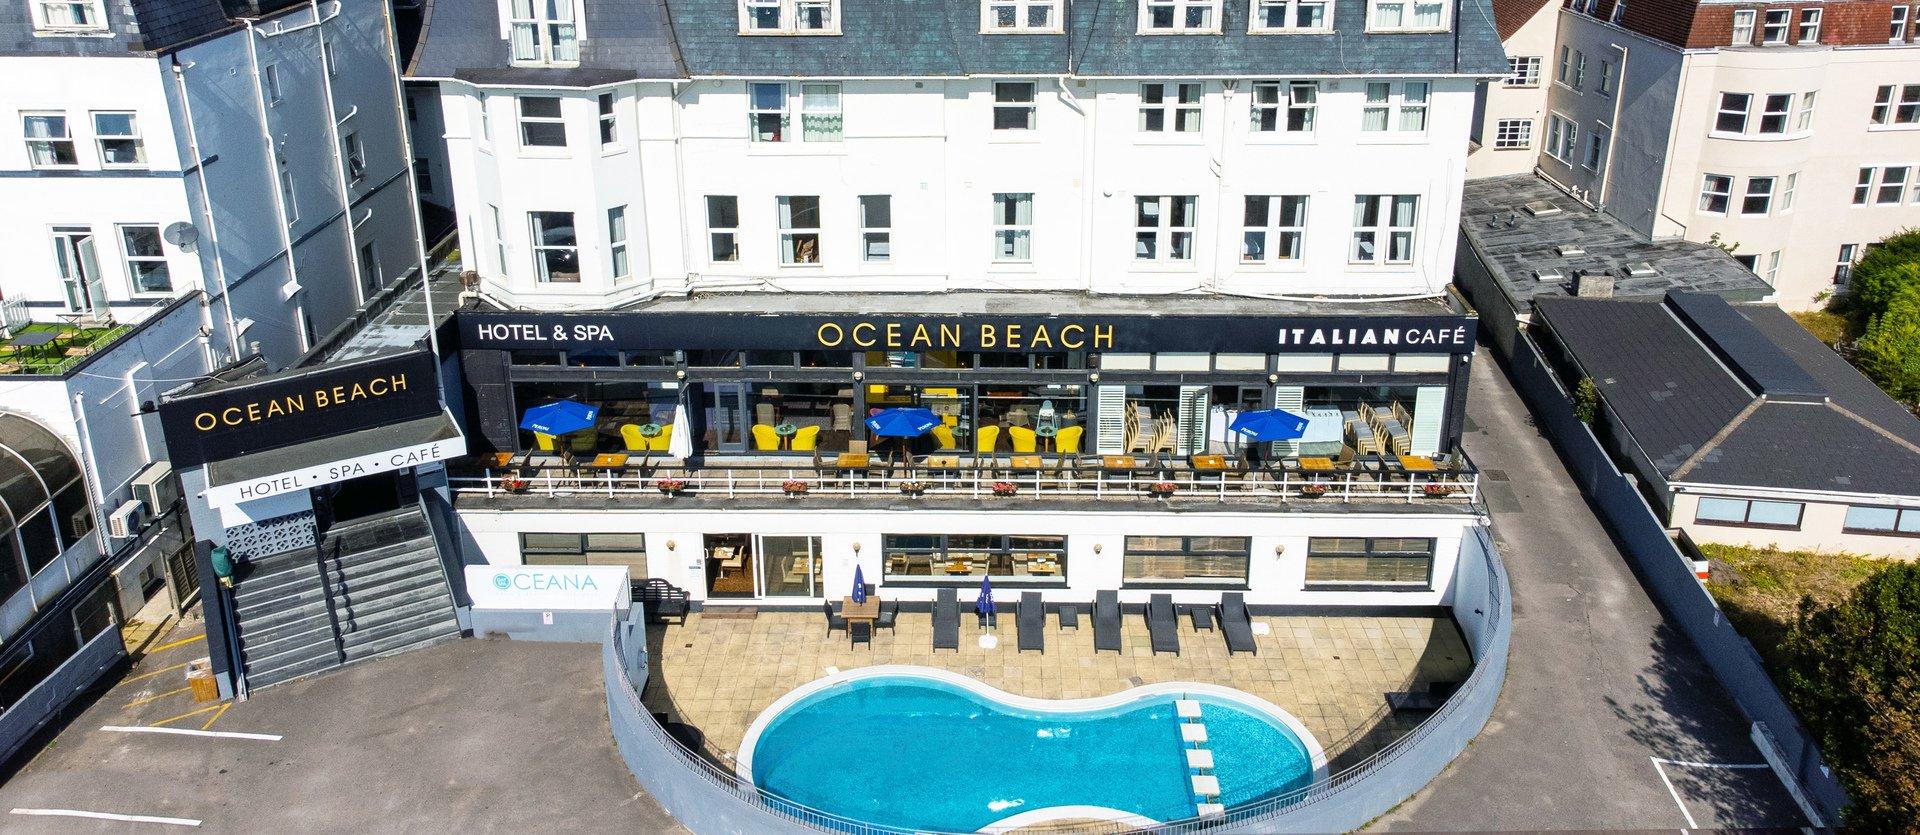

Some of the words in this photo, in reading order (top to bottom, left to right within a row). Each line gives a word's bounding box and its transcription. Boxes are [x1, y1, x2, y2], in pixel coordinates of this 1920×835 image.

[478, 323, 547, 341] HOTEL
[552, 324, 569, 341] &
[573, 324, 614, 341] SPA
[817, 322, 961, 348] OCEAN
[980, 324, 1113, 349] BEACH
[1278, 328, 1400, 345] ITALIAN
[1405, 325, 1466, 345] CAFÉ
[194, 394, 305, 432] OCEAN
[315, 373, 407, 408] BEACH
[240, 475, 302, 499] HOTEL
[329, 462, 365, 480] SPA
[390, 443, 441, 467] CAFÉ
